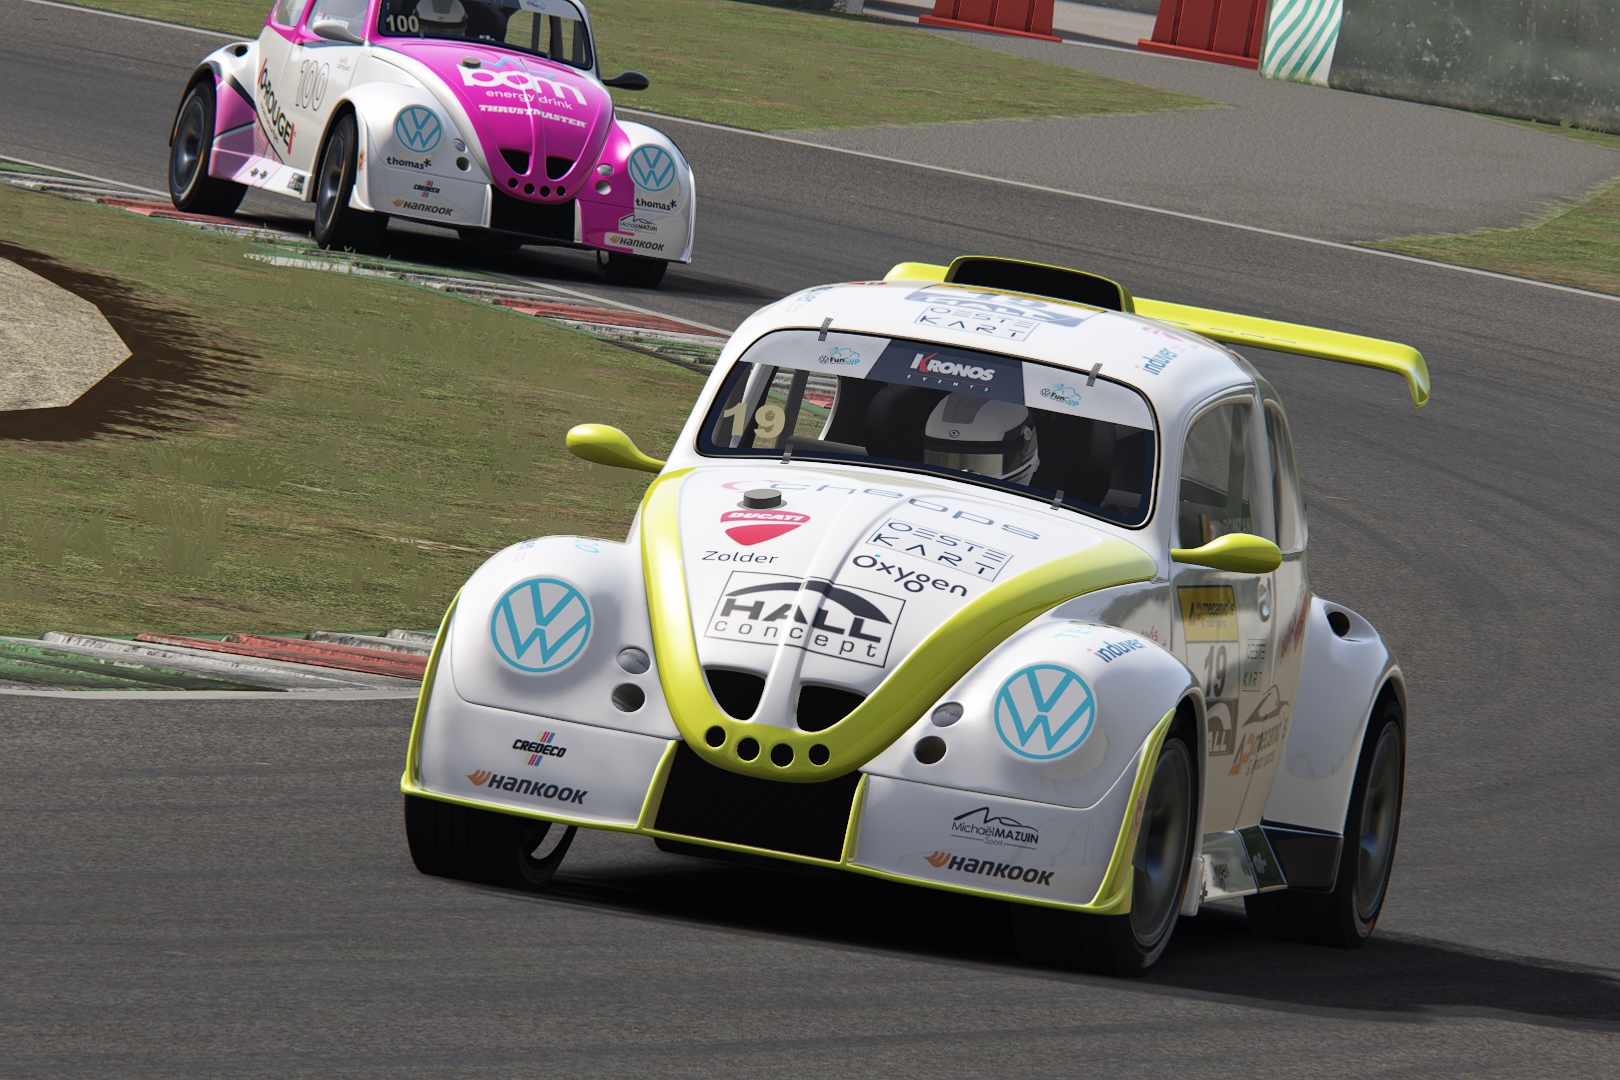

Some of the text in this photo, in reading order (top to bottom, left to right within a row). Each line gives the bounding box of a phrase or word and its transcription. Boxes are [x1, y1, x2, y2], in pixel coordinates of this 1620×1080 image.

[386, 14, 419, 33] 100
[295, 59, 330, 111] 100
[486, 90, 573, 110] energy drink
[478, 104, 588, 128] THRUSTMASTER
[919, 315, 1025, 338] KART
[909, 352, 996, 381] KRONOS
[723, 402, 786, 439] 19
[727, 512, 805, 522] DUCATI
[872, 533, 996, 575] KART
[887, 521, 1008, 563] OESTE
[701, 550, 779, 564] Zolder
[720, 597, 882, 644] HALL
[713, 620, 878, 658] concept
[1087, 638, 1146, 663] induver
[1204, 645, 1227, 697] 19
[512, 738, 567, 758] CREDECO
[984, 836, 1003, 847] Sport
